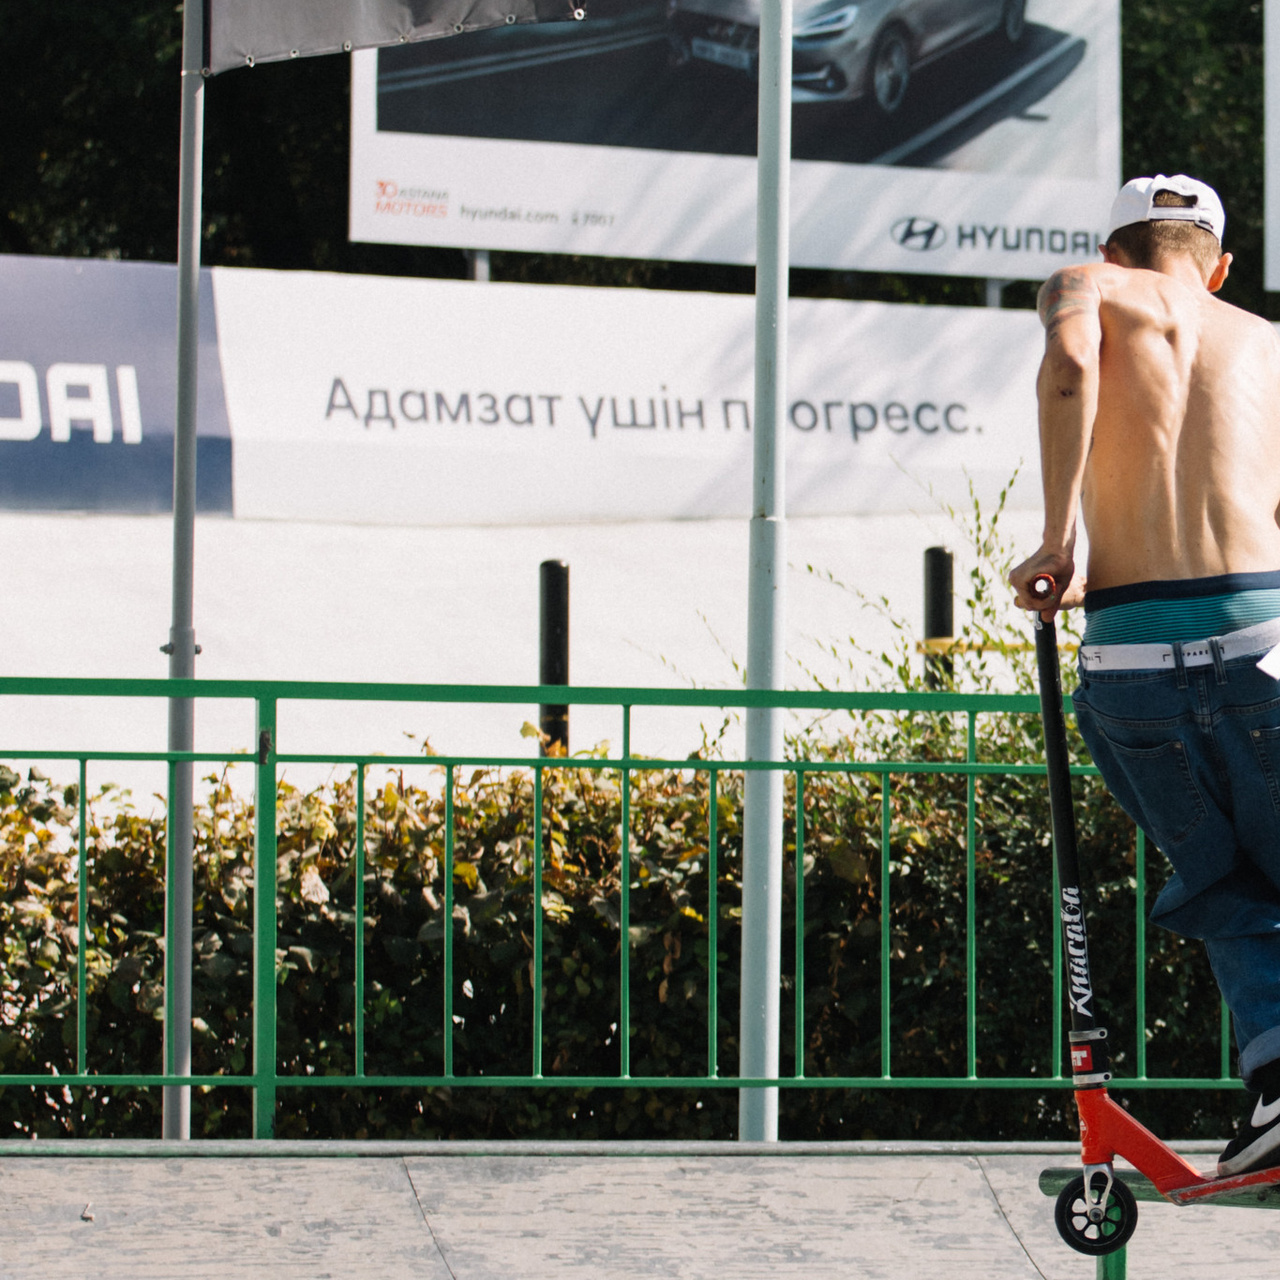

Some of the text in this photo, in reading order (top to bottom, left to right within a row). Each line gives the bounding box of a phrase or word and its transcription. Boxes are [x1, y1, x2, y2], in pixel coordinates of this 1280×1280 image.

[374, 200, 449, 218] MOTORS
[460, 204, 560, 226] hyundai.com
[957, 225, 1099, 256] HYUNDAI
[325, 377, 984, 444] Адамзат үшін погресс.
